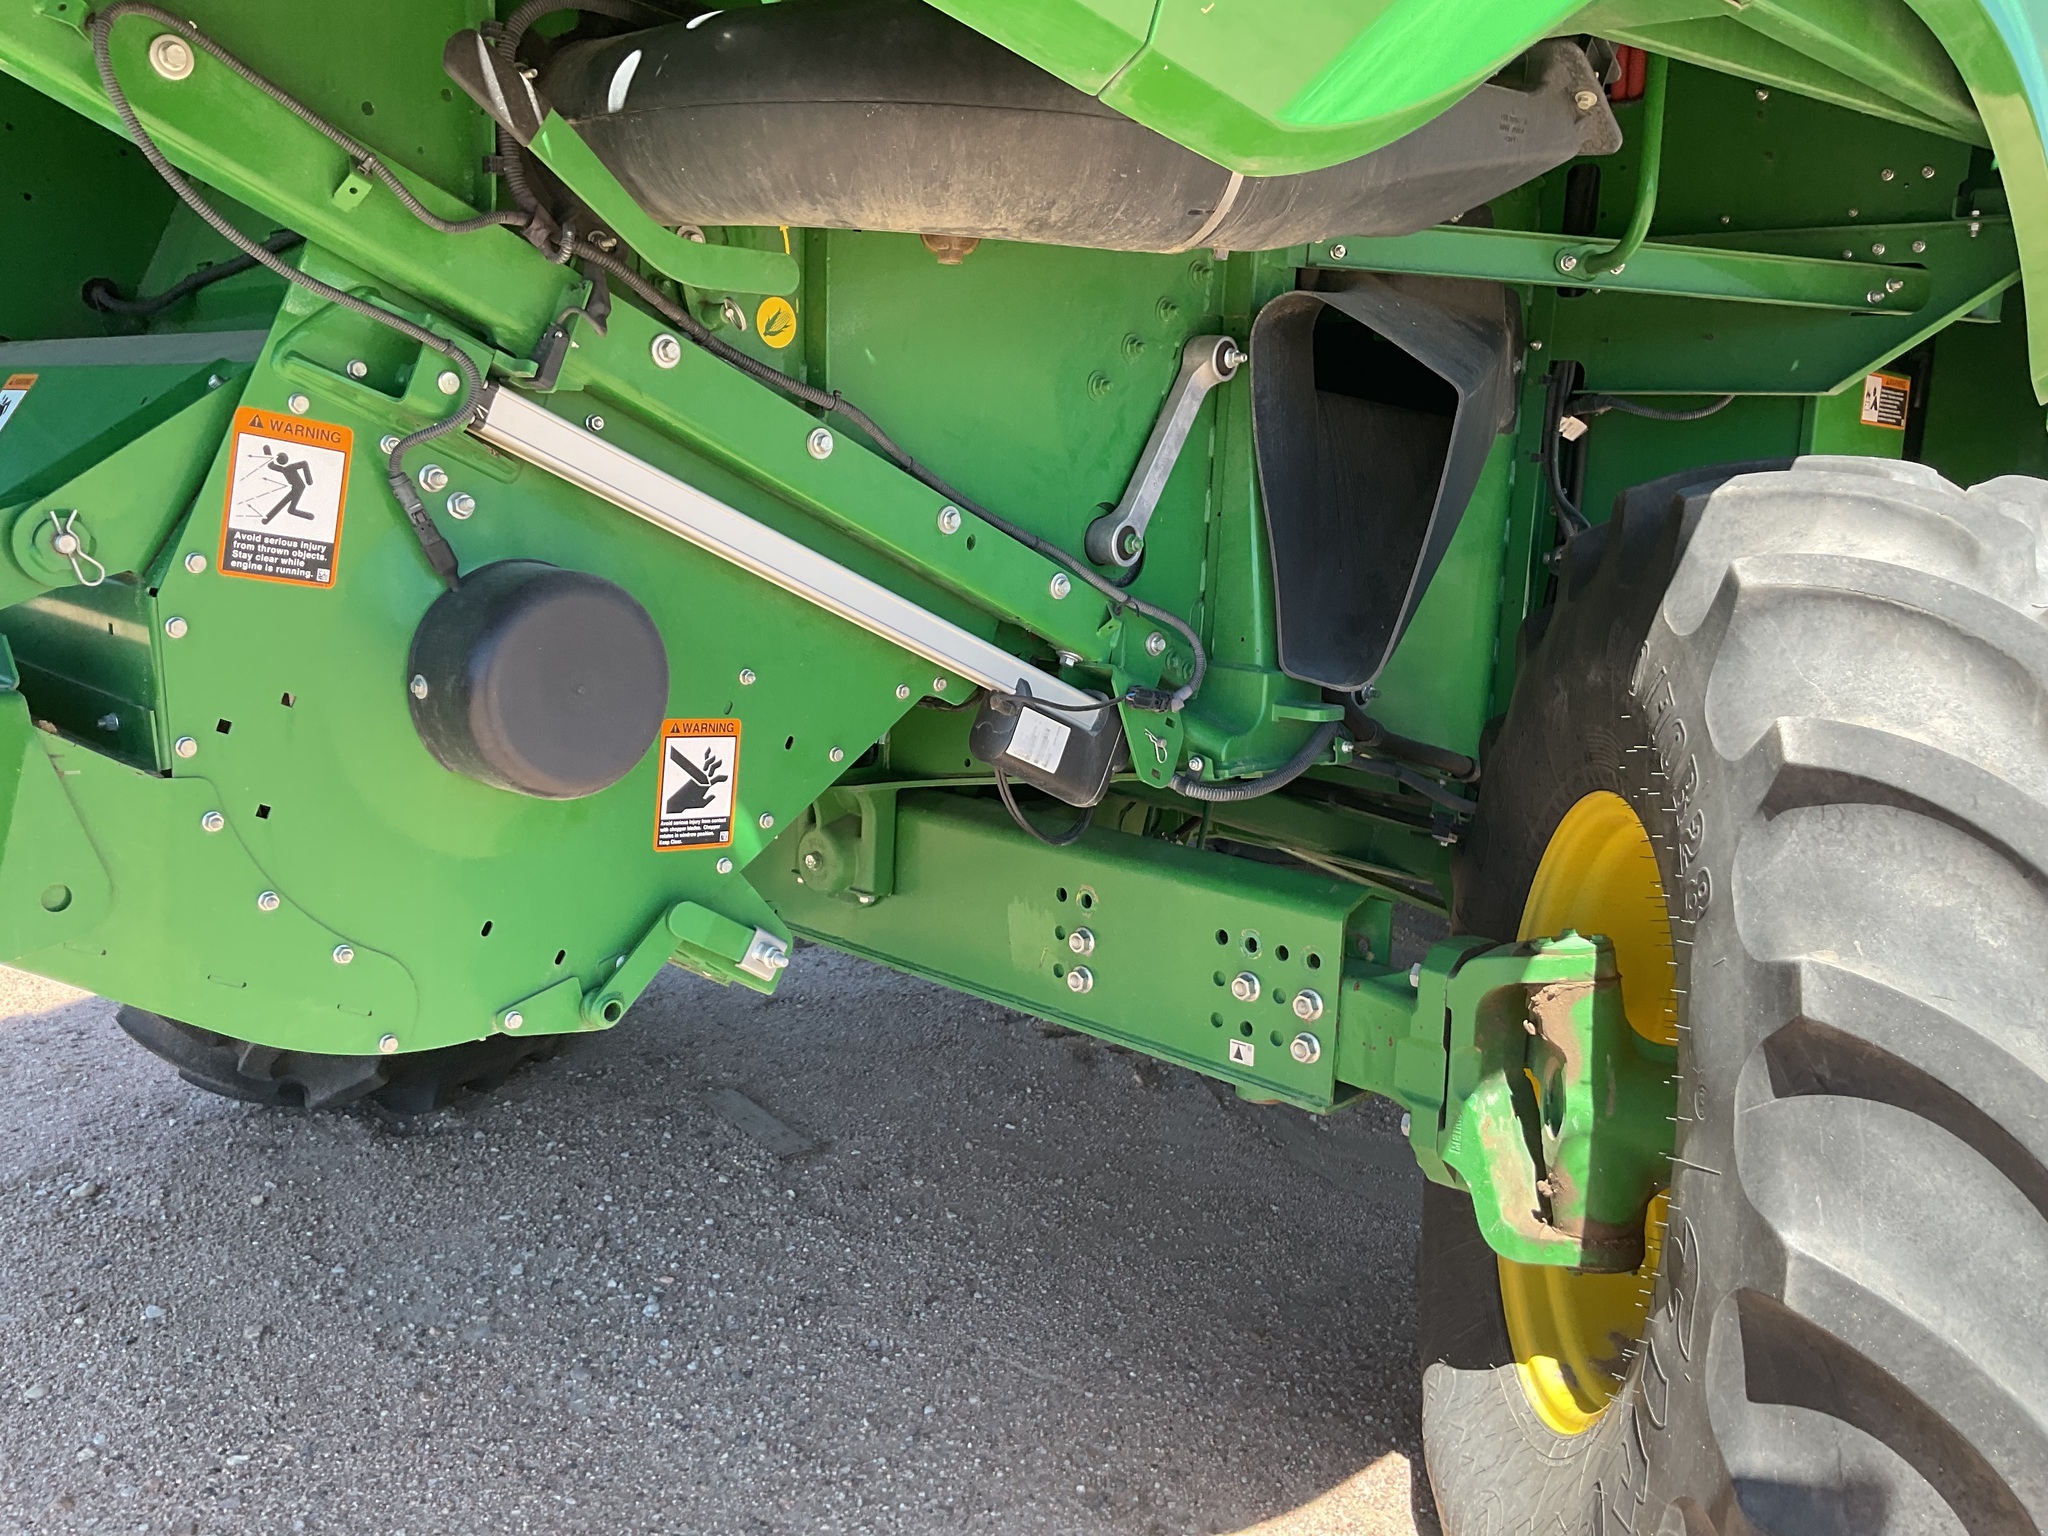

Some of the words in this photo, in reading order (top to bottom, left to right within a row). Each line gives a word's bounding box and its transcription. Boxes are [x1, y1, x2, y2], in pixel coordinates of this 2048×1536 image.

[270, 419, 341, 443] WARNING
[233, 541, 255, 551] from
[257, 544, 289, 556] thrown
[292, 549, 327, 561] objects.
[234, 531, 261, 543] Avoid
[264, 537, 298, 548] serious
[301, 540, 327, 553] injury
[232, 550, 253, 561] Stay
[255, 553, 279, 563] clear
[281, 557, 305, 567] while
[230, 560, 262, 571] engine
[265, 563, 274, 572] is
[276, 566, 314, 579] running.
[682, 723, 734, 733] WARNING
